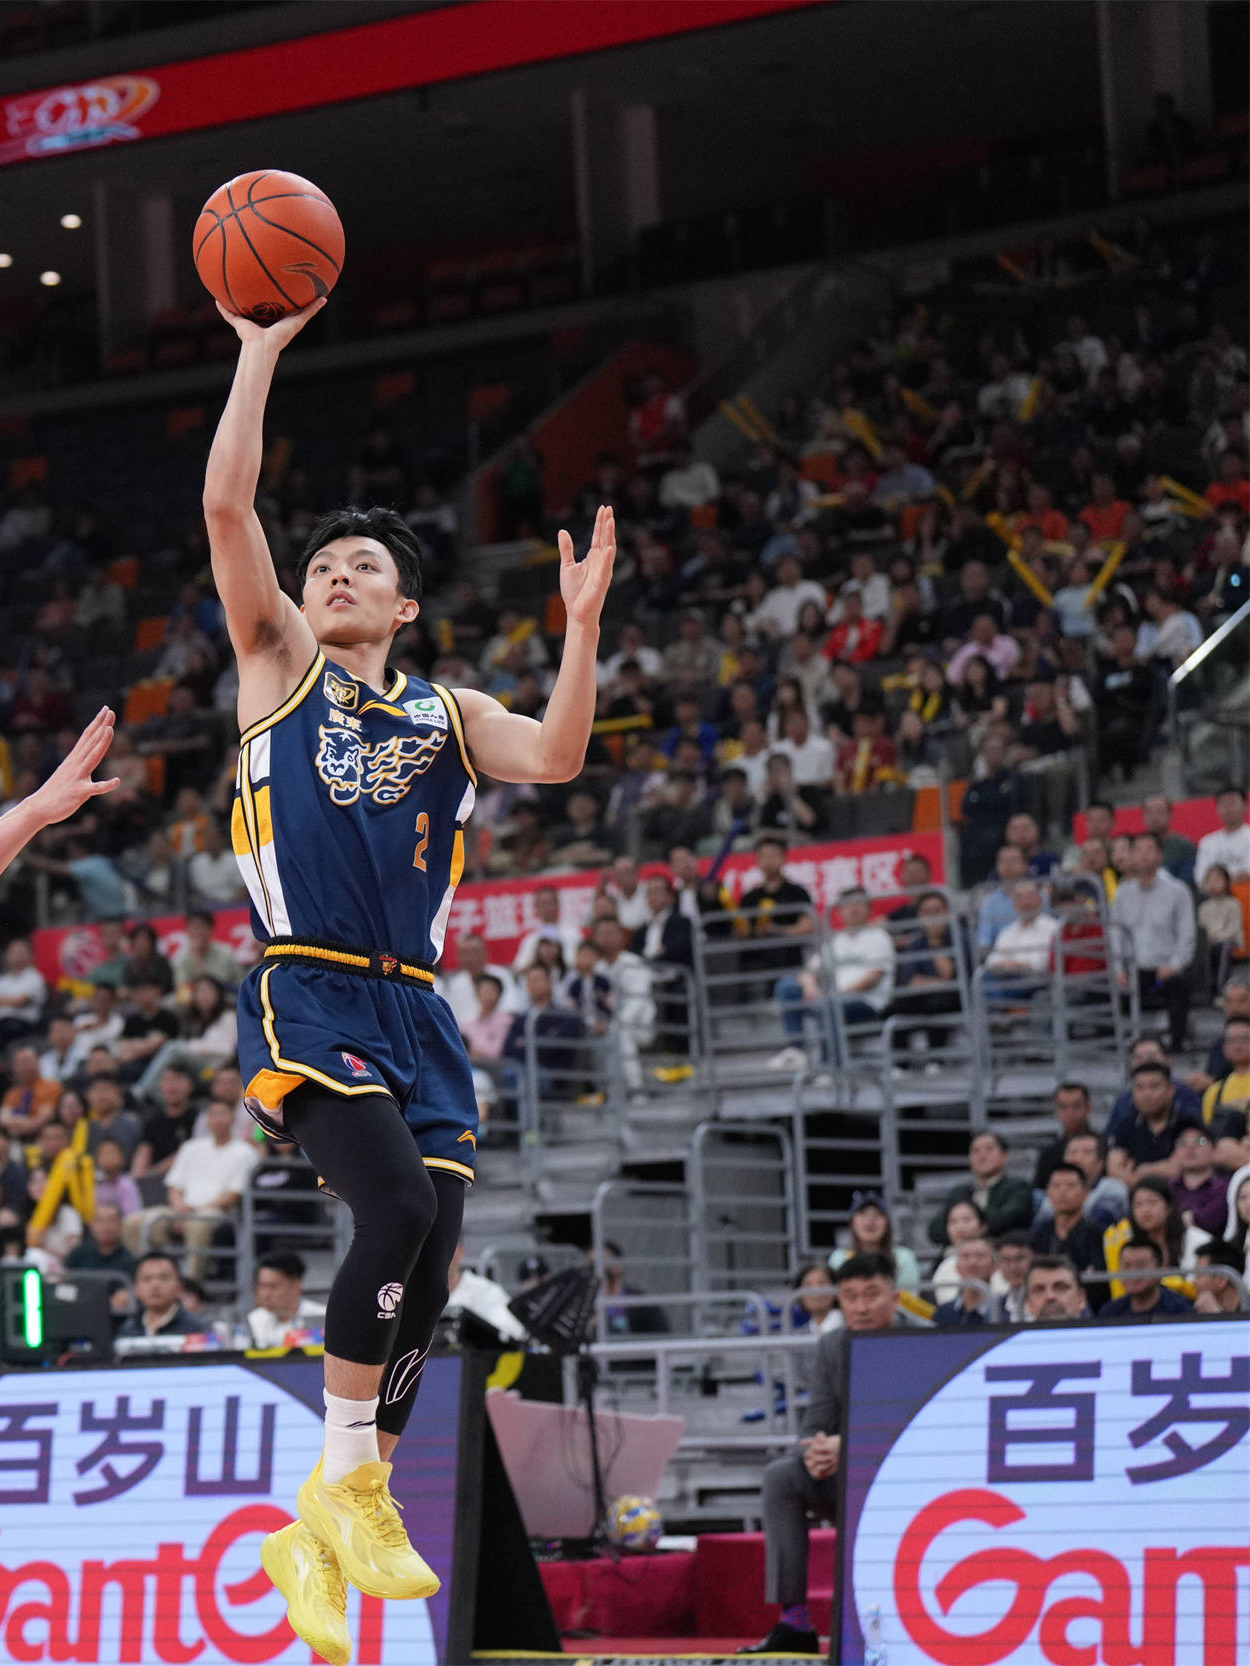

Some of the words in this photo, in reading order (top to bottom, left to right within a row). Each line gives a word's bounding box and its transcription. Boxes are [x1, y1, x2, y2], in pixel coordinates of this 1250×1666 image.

[413, 811, 431, 873] 2
[377, 1311, 397, 1320] CBA
[984, 1351, 1250, 1486] 百岁
